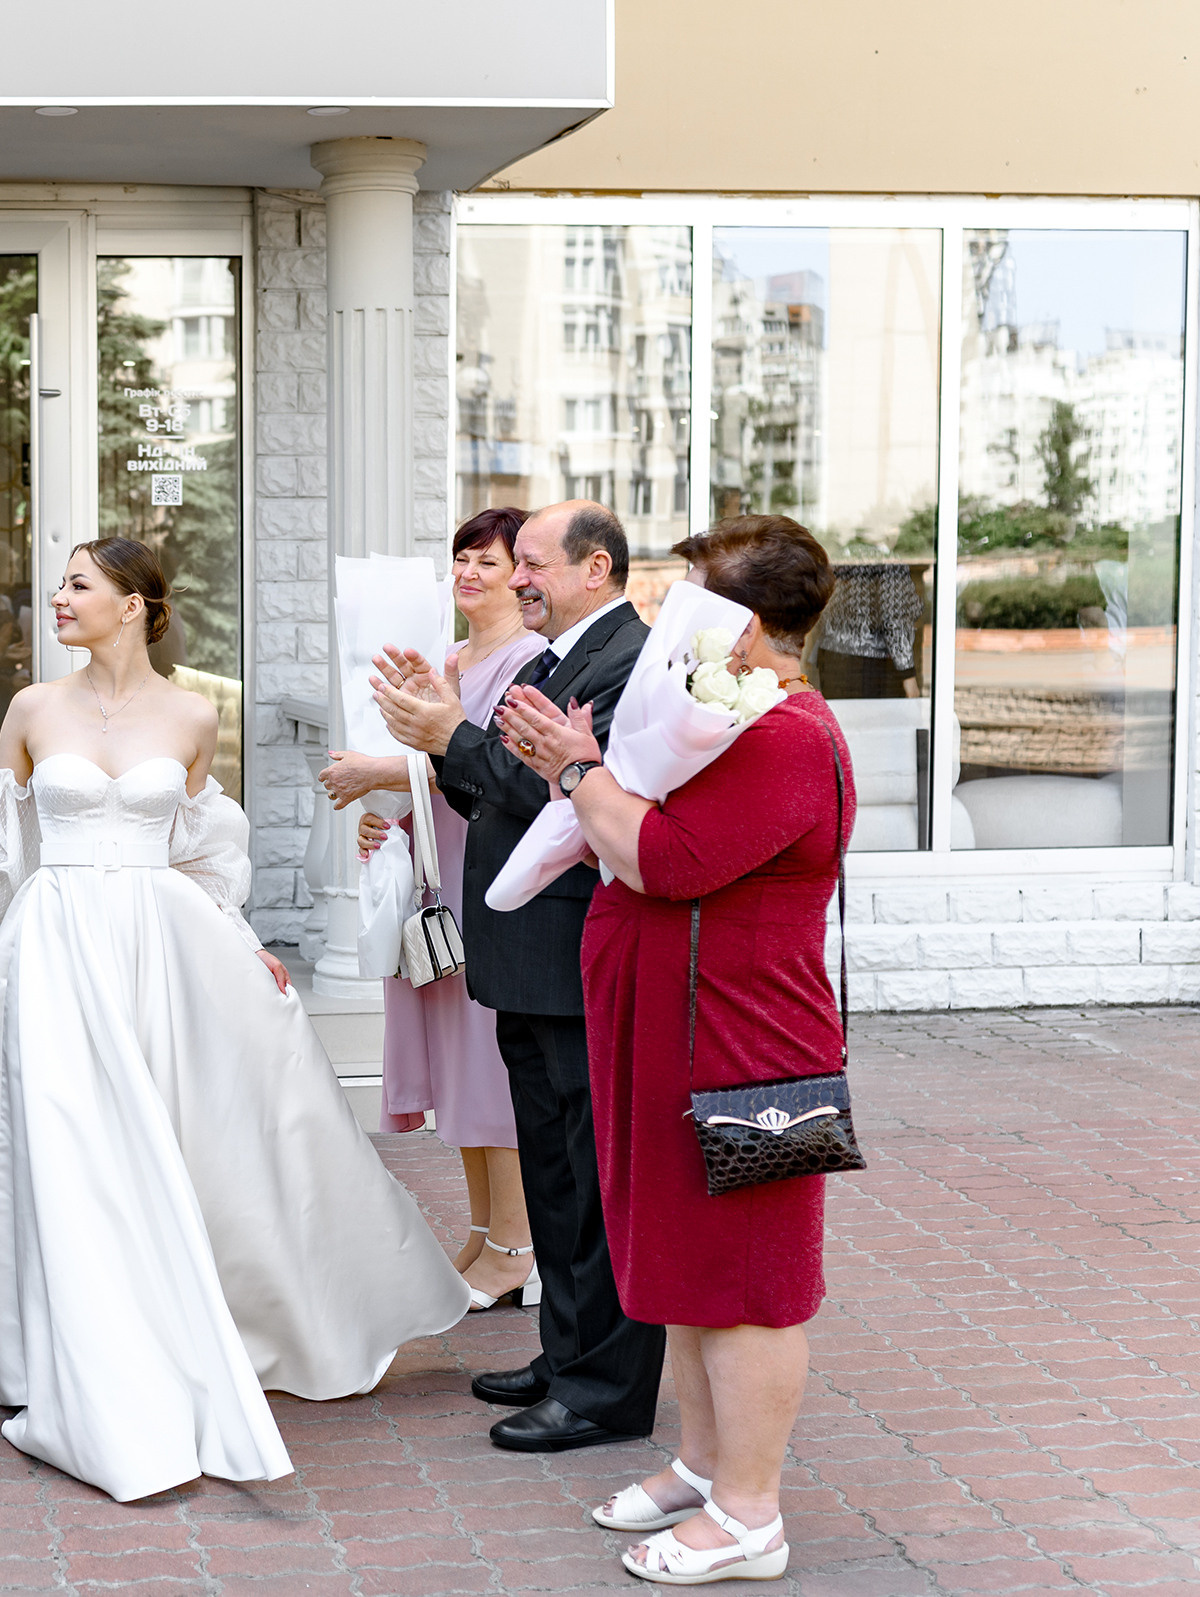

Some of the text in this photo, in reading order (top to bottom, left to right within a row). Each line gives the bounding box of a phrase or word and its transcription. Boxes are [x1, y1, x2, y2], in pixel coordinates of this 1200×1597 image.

[123, 388, 161, 399] Графік
[145, 419, 184, 432] 9-18
[127, 457, 208, 471] вихідний
